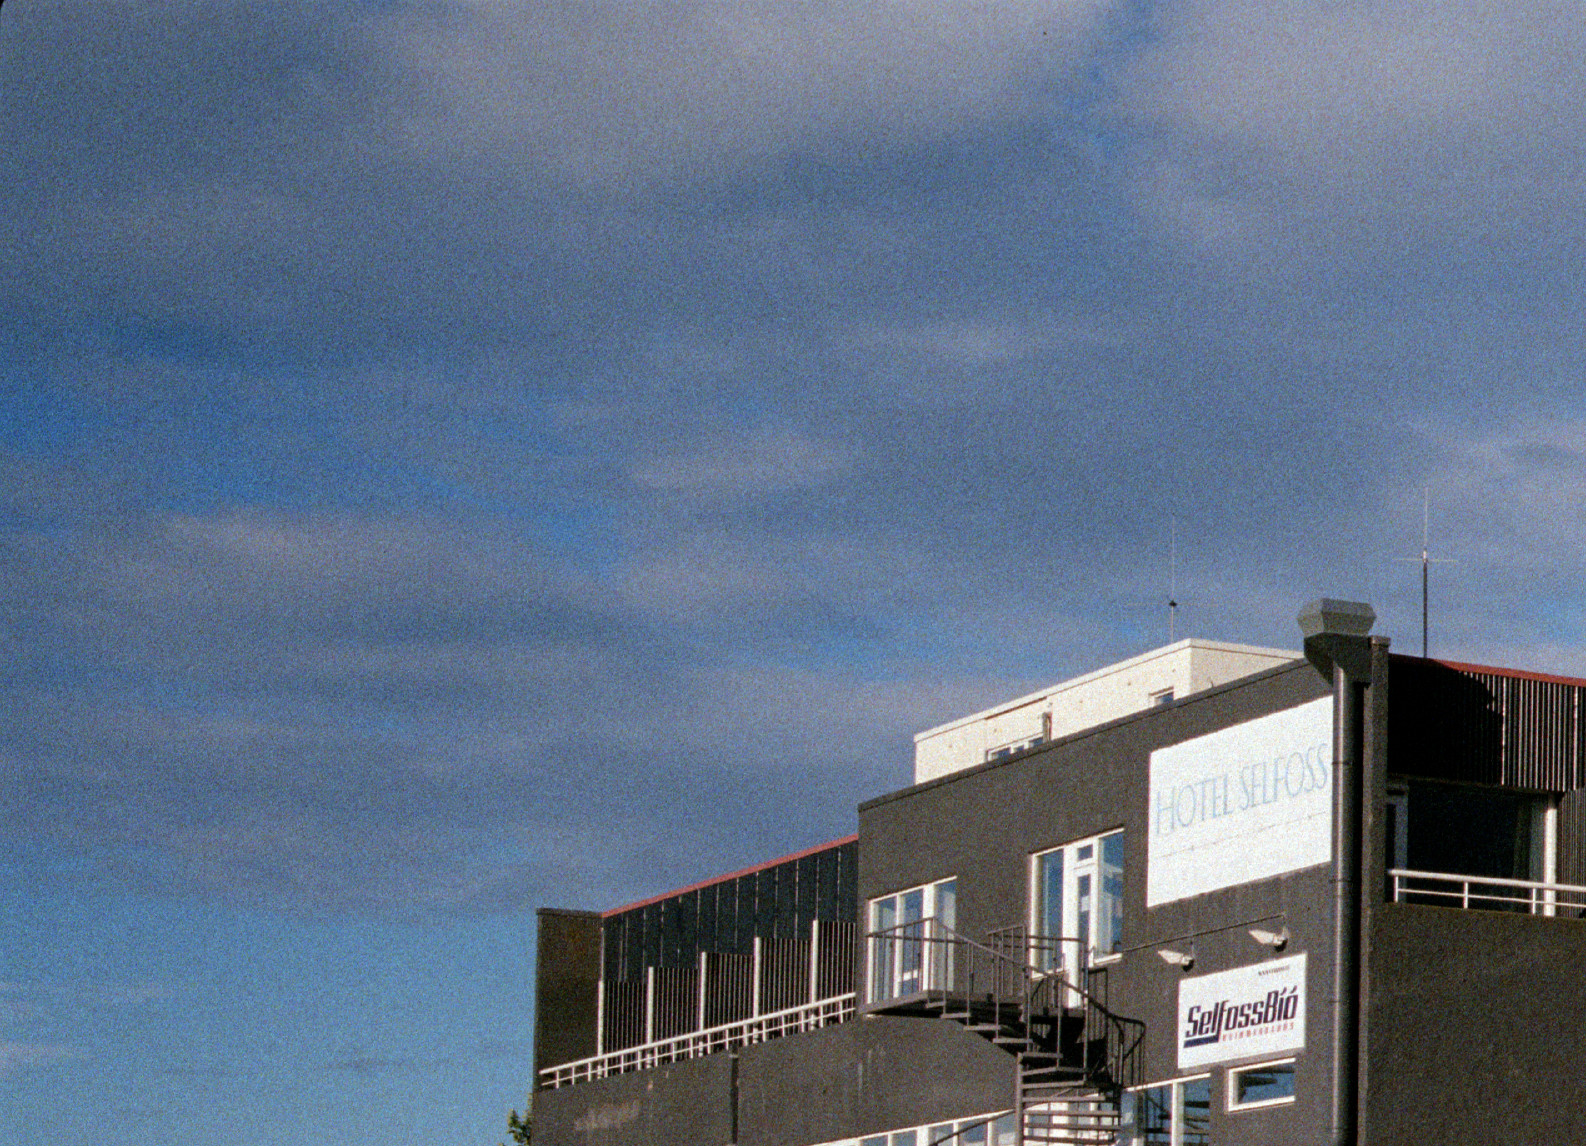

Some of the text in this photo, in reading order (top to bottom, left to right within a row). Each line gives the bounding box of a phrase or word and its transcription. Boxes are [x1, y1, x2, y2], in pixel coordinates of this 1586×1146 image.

[1155, 742, 1328, 836] HOTEL SELFOSS
[1183, 984, 1299, 1048] SelfossBíó
